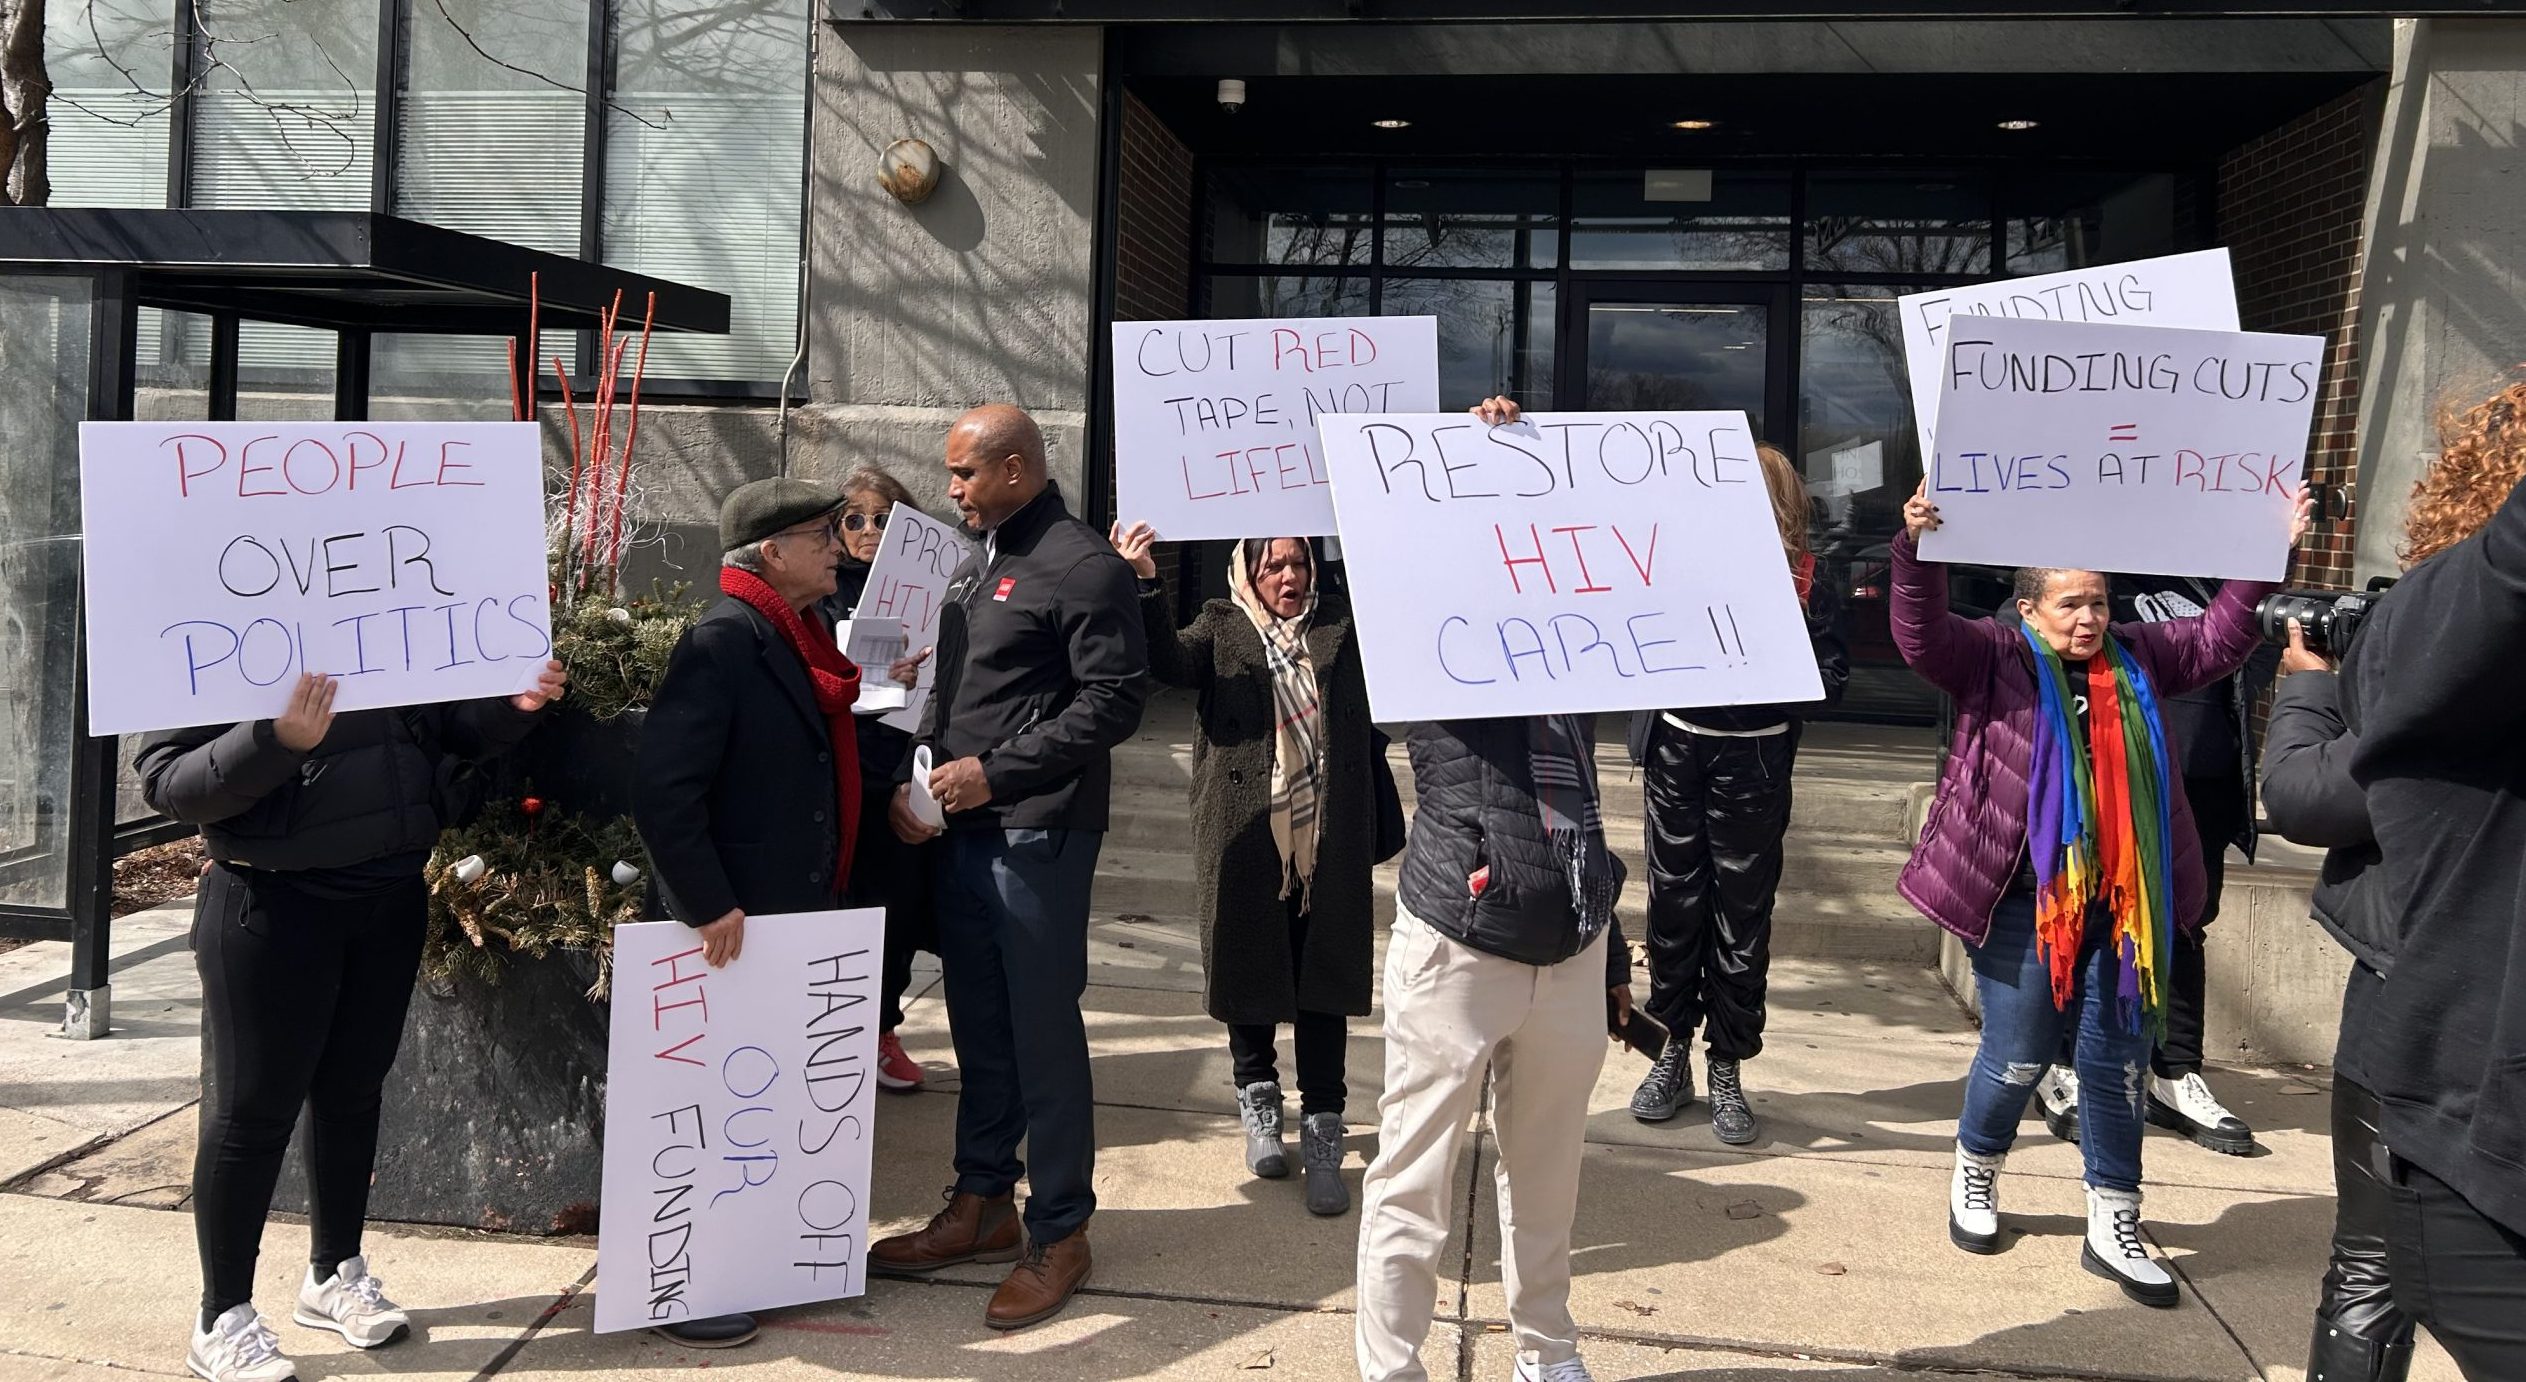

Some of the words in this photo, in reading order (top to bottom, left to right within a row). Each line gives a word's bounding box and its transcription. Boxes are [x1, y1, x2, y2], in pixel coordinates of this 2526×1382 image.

[1138, 328, 1249, 377] CUT
[1270, 328, 1377, 373] RED
[1952, 341, 2180, 394] FUNDING
[2193, 356, 2313, 403] CUTS
[1164, 394, 1294, 436] TAPE,
[1302, 381, 1405, 428] NOT
[159, 431, 486, 498] PEOPLE
[1182, 443, 1331, 500] LIFEL
[1360, 420, 1750, 503] RESTORE
[1936, 452, 2071, 493] LIVES
[2098, 452, 2161, 485] AT
[2174, 449, 2295, 500] RISK
[218, 524, 455, 598] OVER
[901, 517, 968, 579] PRO
[1494, 522, 1659, 595] HIV
[875, 574, 943, 633] HIV
[160, 594, 551, 696] POLITICS
[651, 946, 708, 1067] HIV
[799, 948, 871, 1155] HANDS
[709, 1045, 780, 1210] OUR
[647, 1103, 706, 1321] FUNDING
[793, 1179, 857, 1294] OFF
